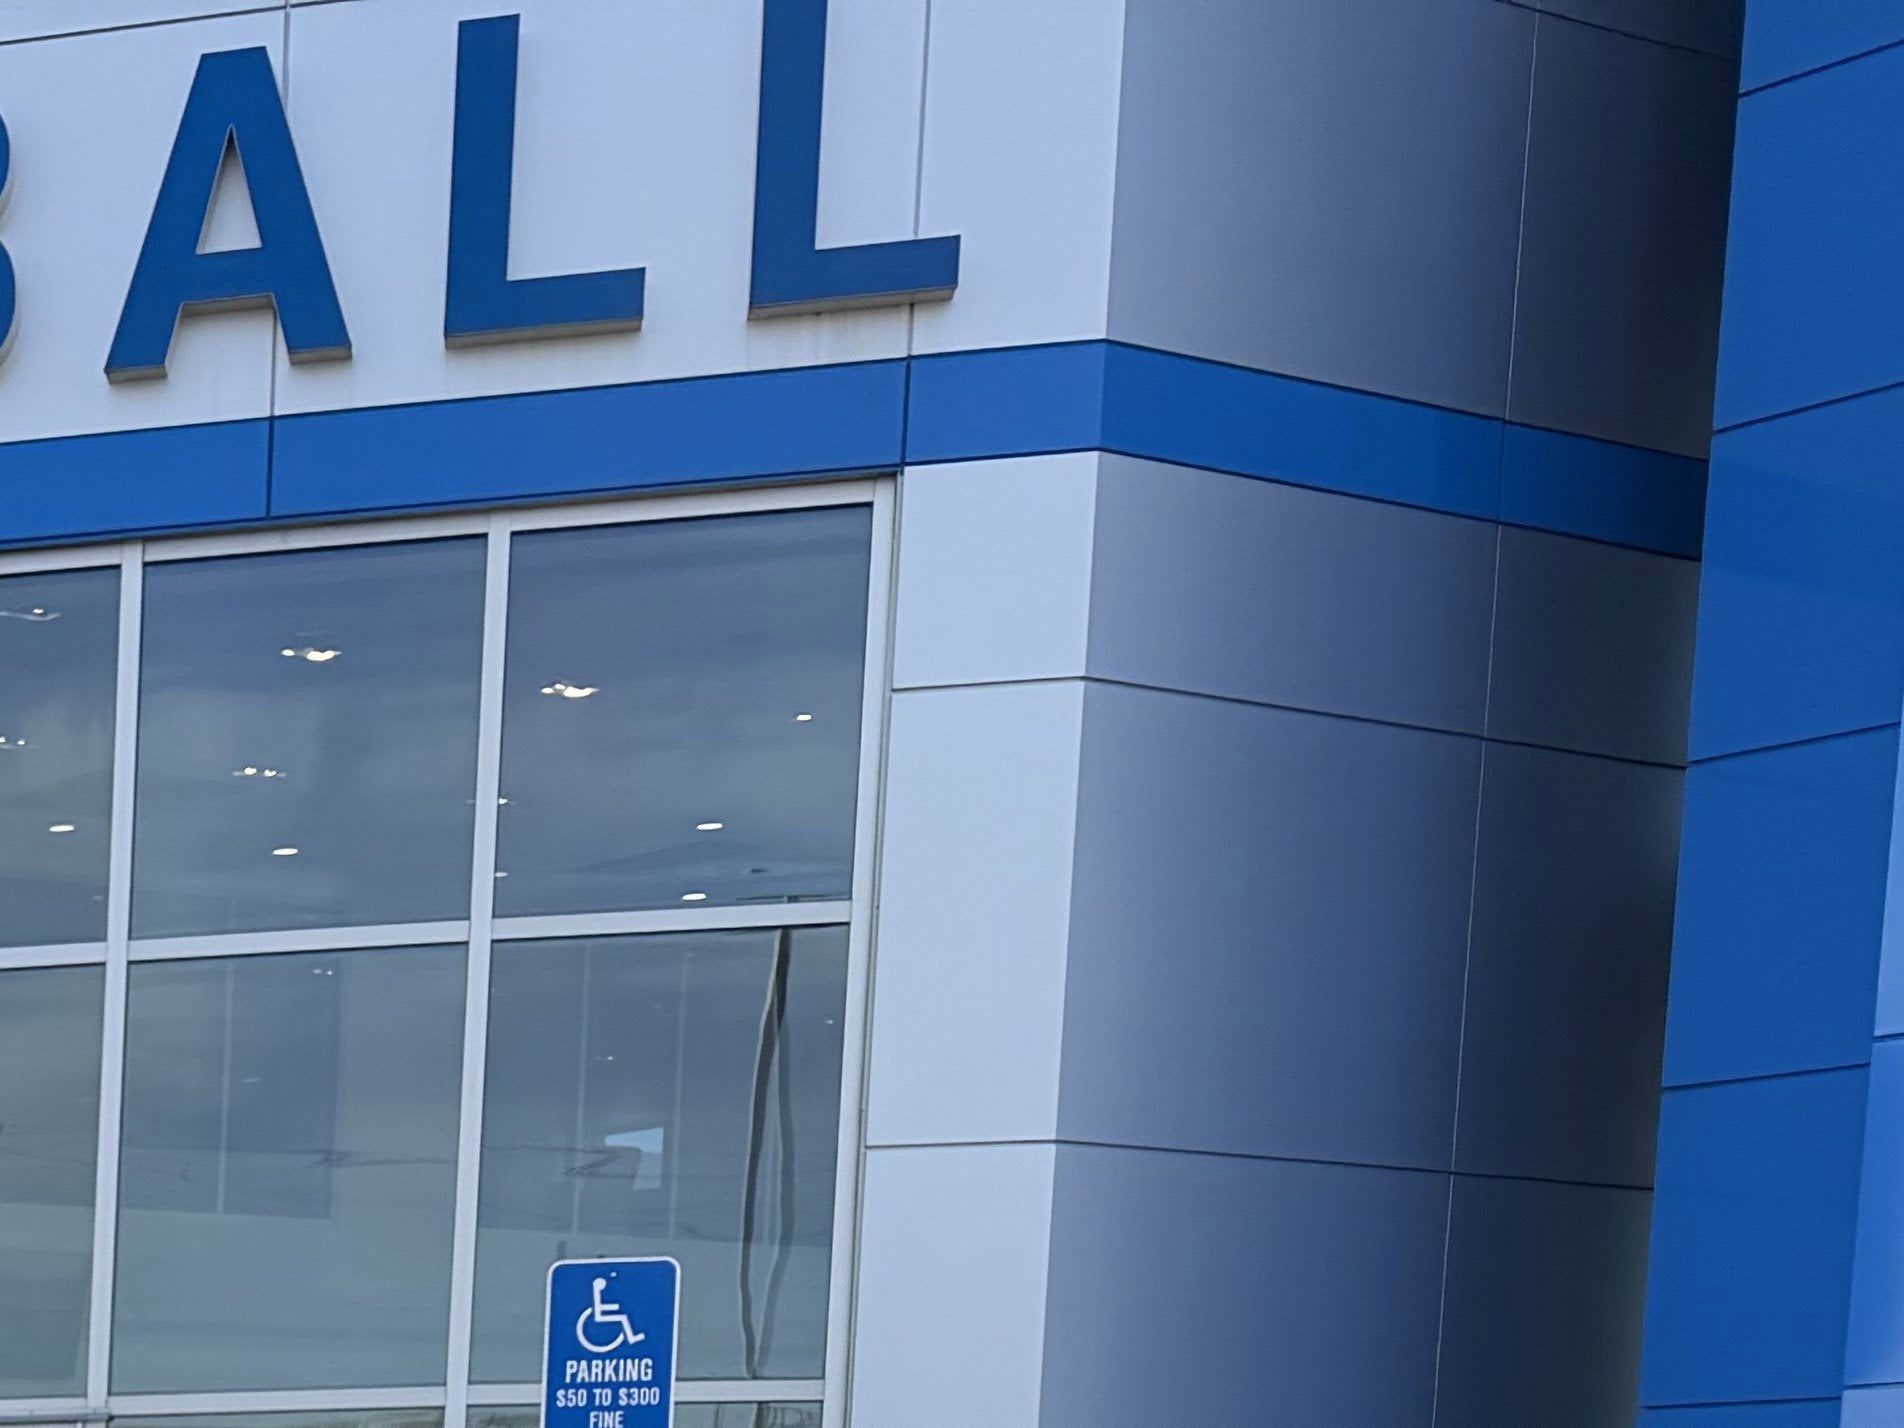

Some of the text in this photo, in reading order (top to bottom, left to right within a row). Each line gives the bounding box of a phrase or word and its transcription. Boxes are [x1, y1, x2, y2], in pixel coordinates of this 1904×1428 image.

[565, 1358, 654, 1383] PARKING
[556, 1386, 660, 1408] $50 TO $300
